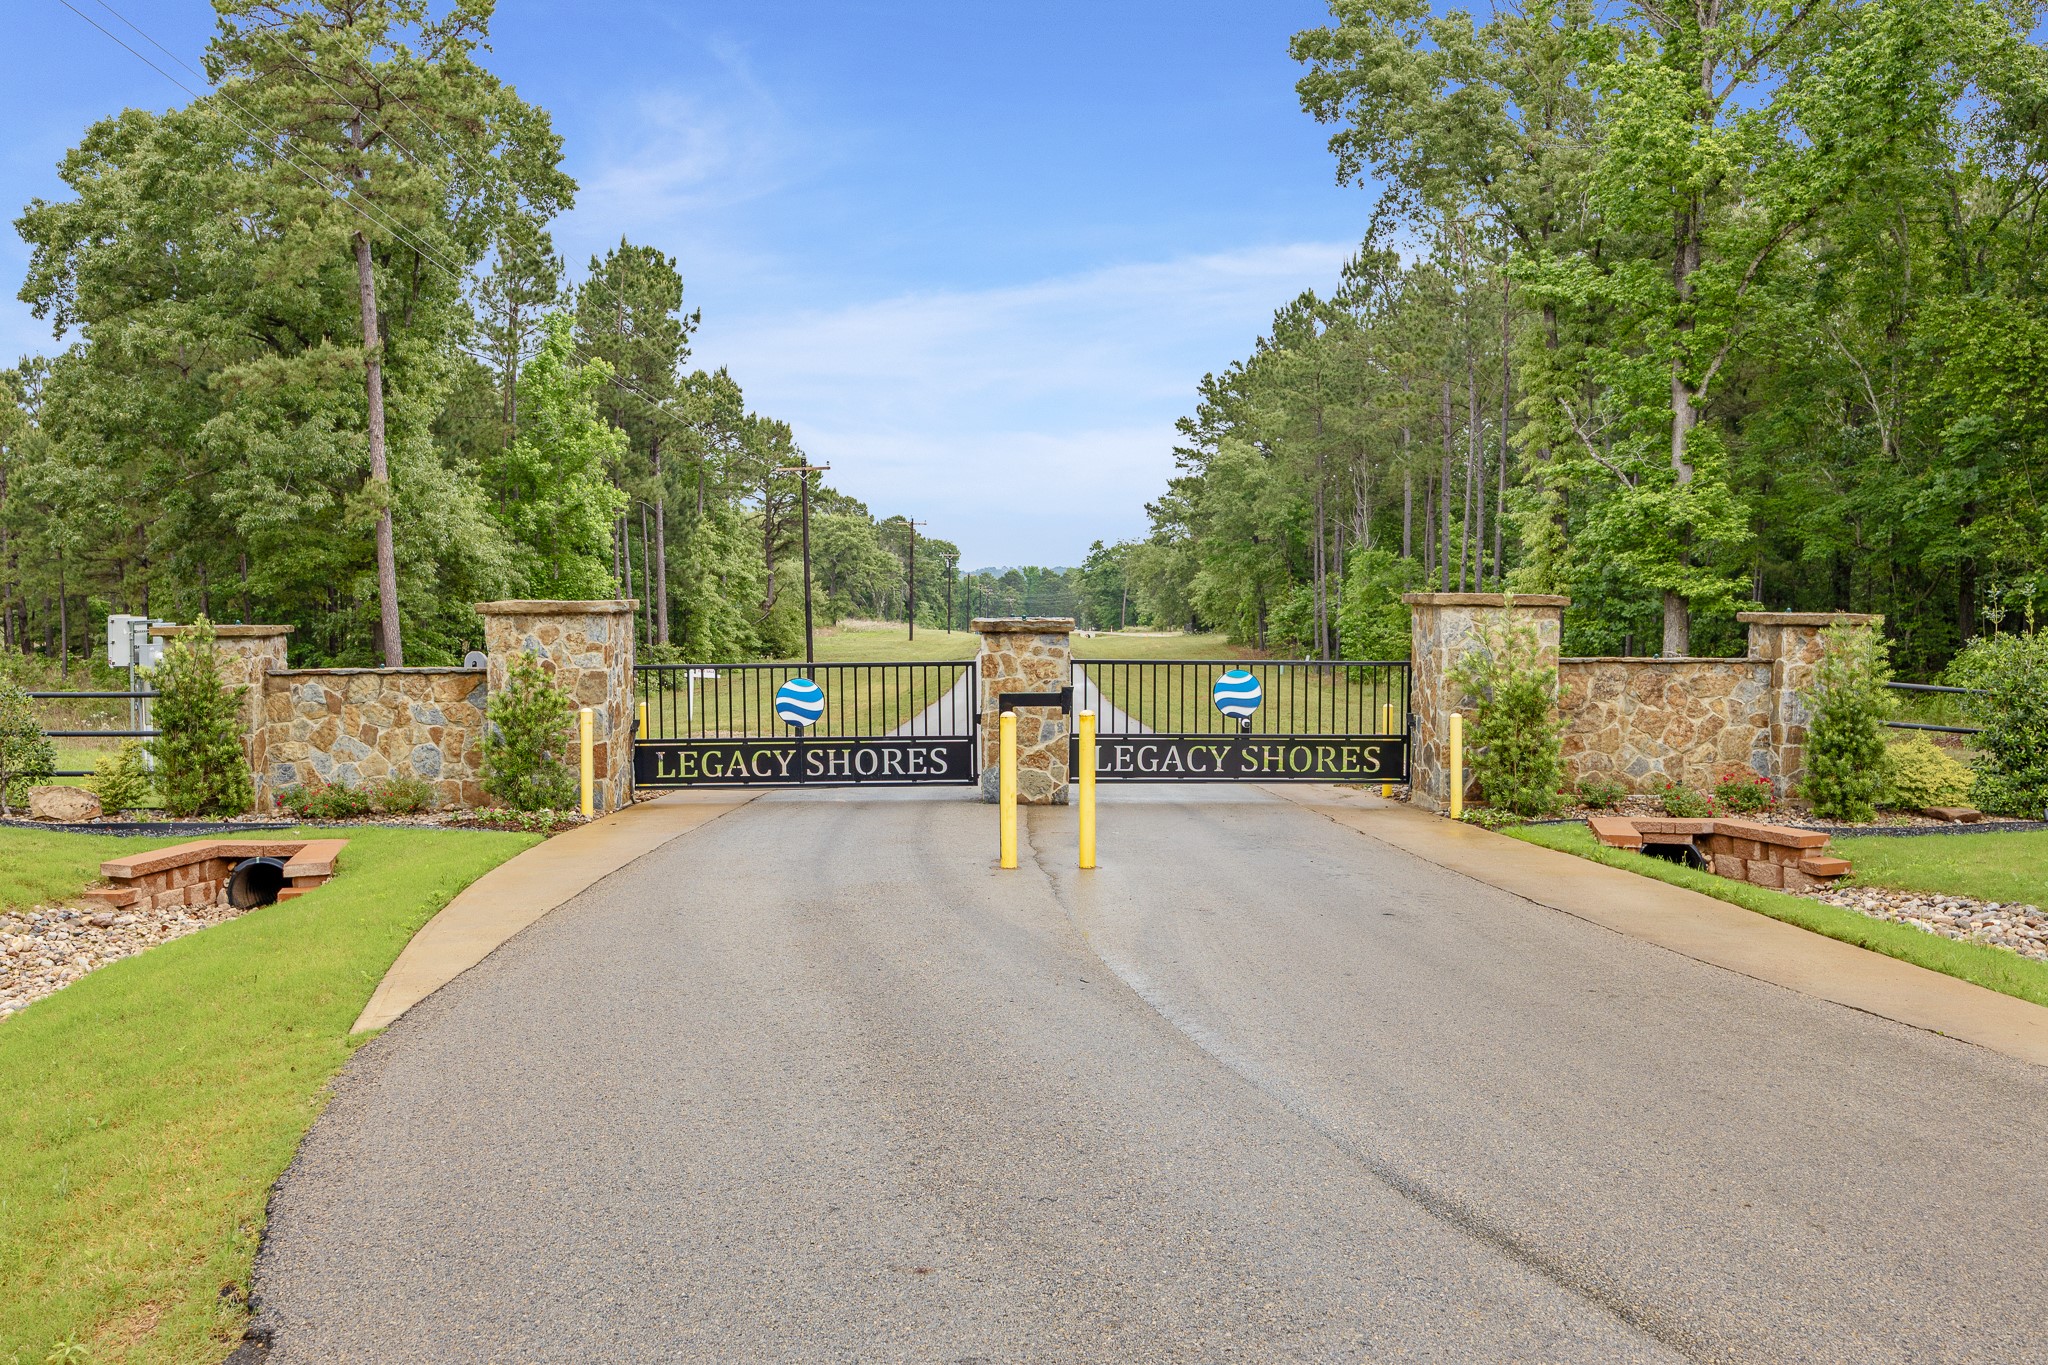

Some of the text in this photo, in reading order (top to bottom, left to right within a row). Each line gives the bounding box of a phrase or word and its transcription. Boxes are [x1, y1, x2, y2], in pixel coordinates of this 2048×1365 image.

[656, 748, 948, 778] LEGACY SHORES
[1095, 745, 1381, 773] LEGACY SHORES
